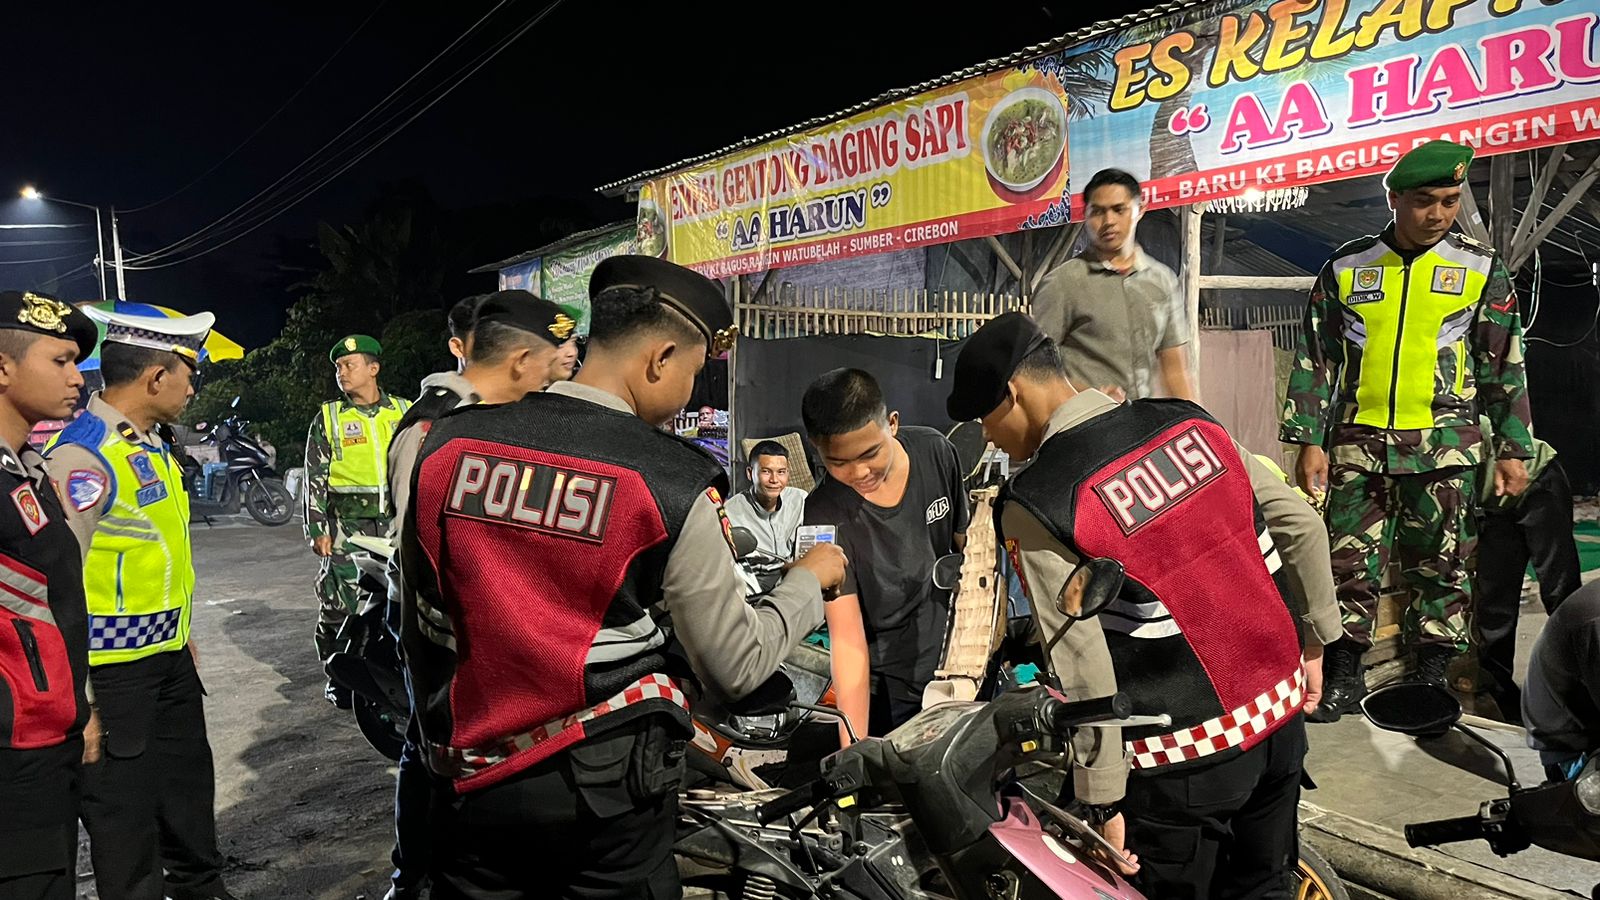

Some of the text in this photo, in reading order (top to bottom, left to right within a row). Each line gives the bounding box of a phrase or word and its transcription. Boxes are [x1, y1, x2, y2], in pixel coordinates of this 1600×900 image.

[1109, 0, 1562, 112] ES KELAP
[671, 100, 967, 221] EMPAL GENTONG DAGING SAPI
[1141, 185, 1170, 206] JL.
[1179, 169, 1245, 199] BARU
[1256, 163, 1286, 185] KI
[1297, 142, 1400, 179] BAGUS
[782, 241, 840, 263] WATUBELAH
[850, 232, 893, 253] SUMBER
[904, 221, 959, 244] CIREBON
[450, 455, 613, 537] POLISI
[1100, 429, 1223, 529] POLISI
